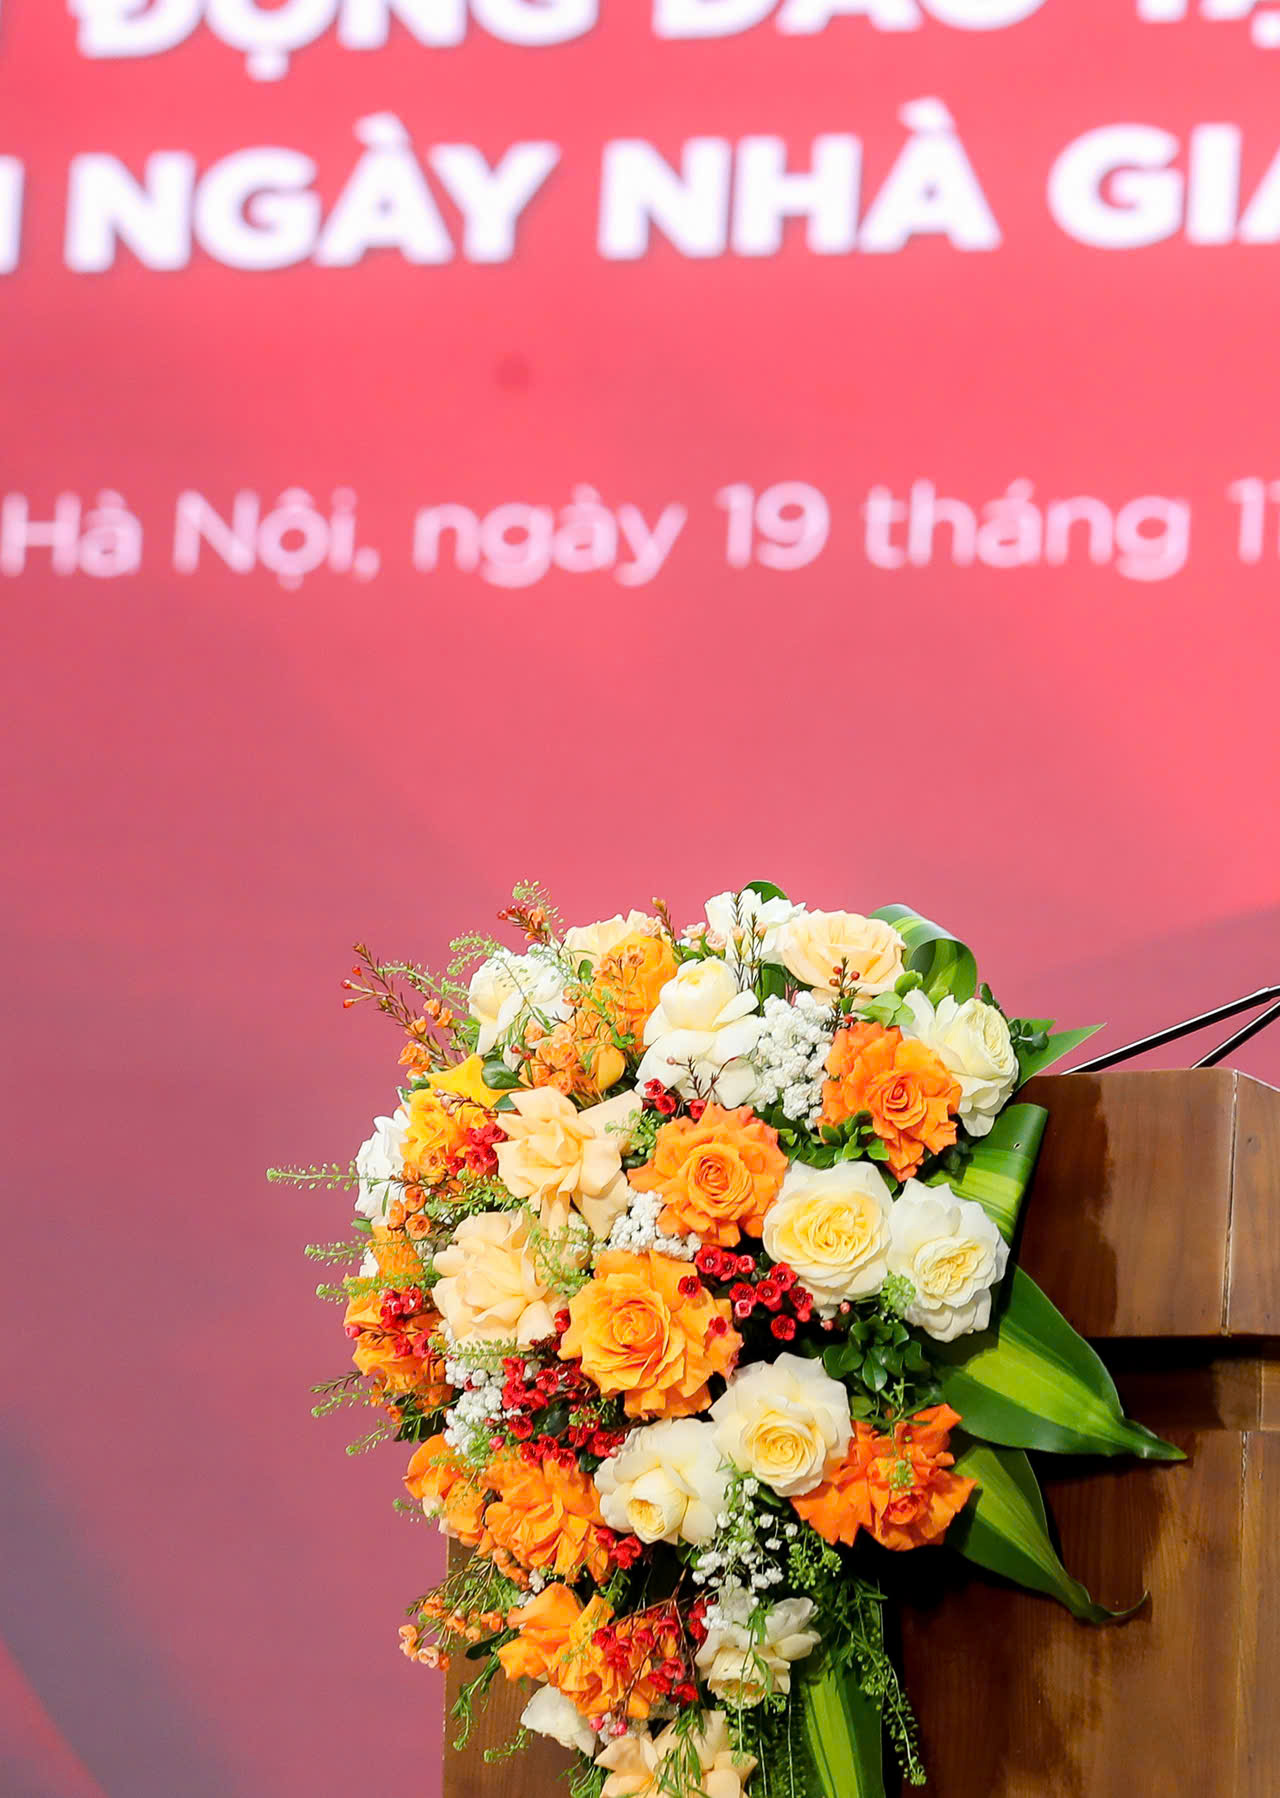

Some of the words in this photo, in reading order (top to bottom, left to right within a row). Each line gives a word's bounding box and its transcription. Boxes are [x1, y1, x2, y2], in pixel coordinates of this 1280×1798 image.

[64, 110, 561, 274] NGÀY
[597, 96, 1003, 261] NHÀ
[0, 488, 143, 578] Hà
[173, 487, 381, 591] Nội,
[412, 483, 687, 588] ngày
[716, 481, 831, 570] 19
[862, 478, 1192, 582] tháng
